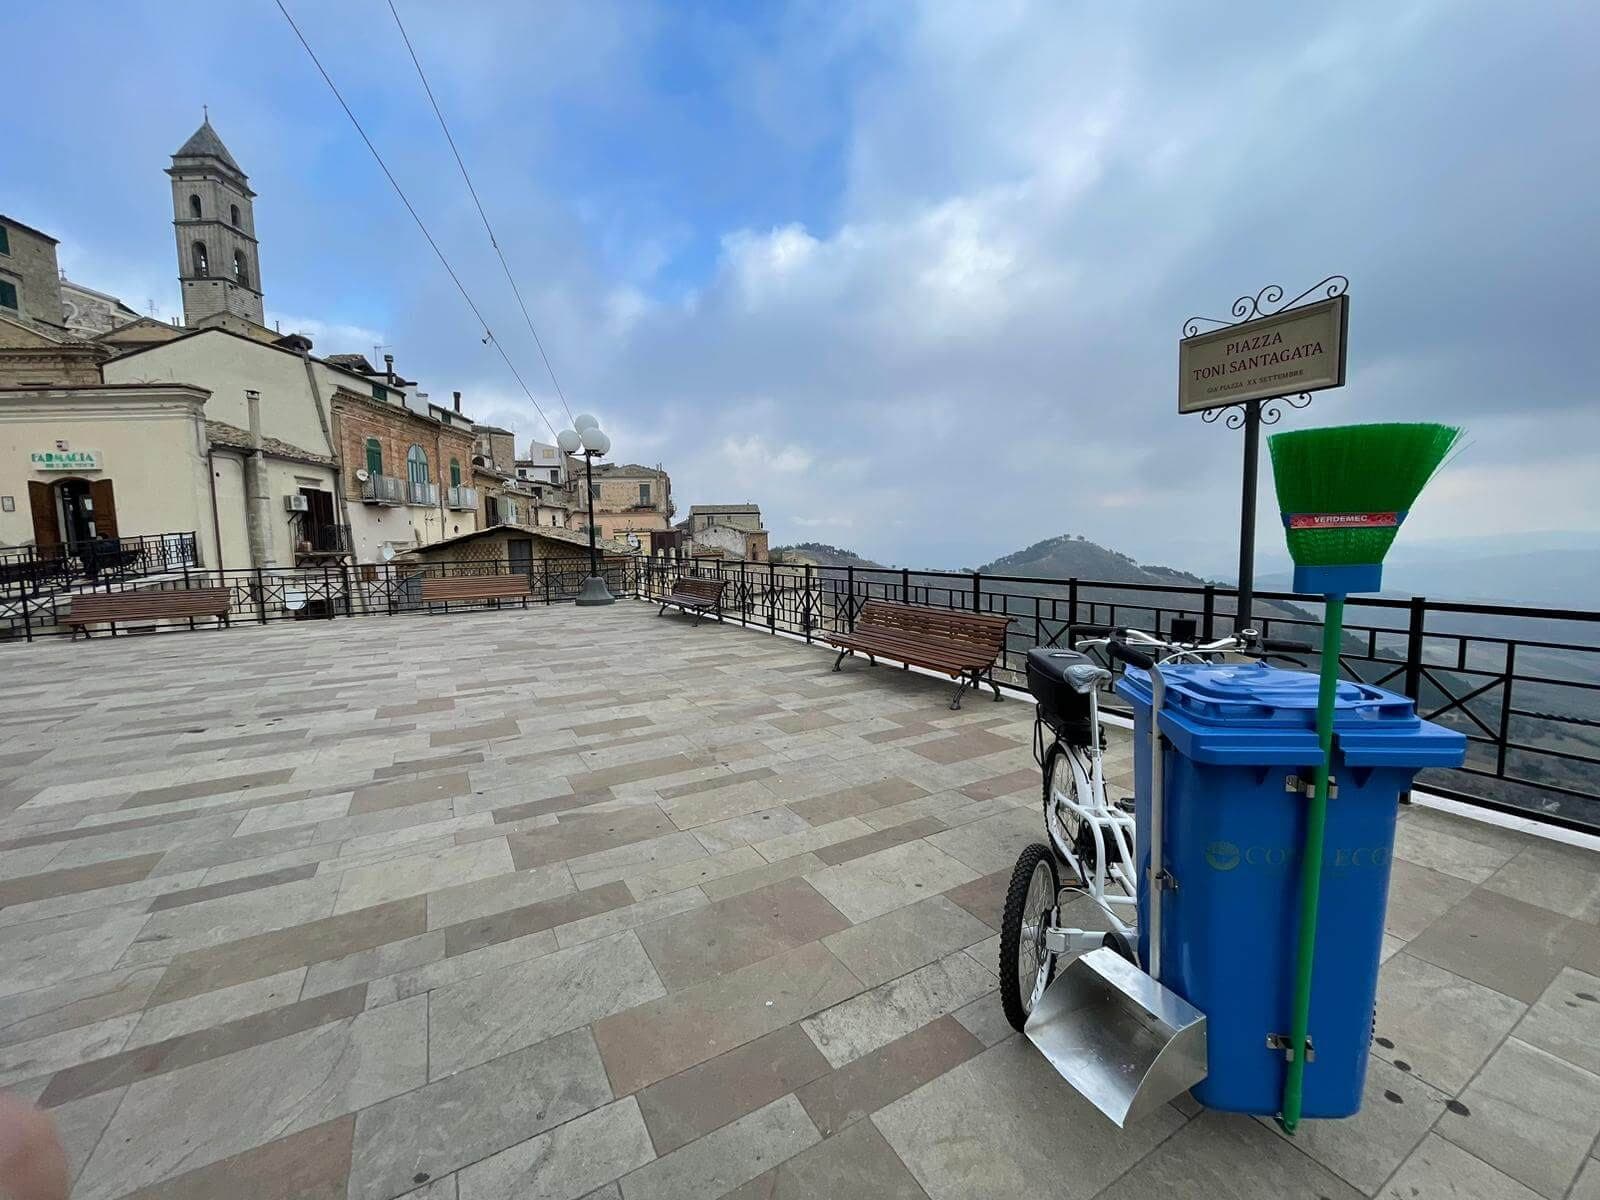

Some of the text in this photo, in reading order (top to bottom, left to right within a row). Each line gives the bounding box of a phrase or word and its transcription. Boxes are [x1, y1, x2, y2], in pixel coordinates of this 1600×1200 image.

[1226, 332, 1283, 356] PIAZZA
[1193, 342, 1323, 381] TONI SANTAGATA
[1219, 382, 1243, 391] PIAZZA
[1259, 369, 1304, 383] SETTEMBRE
[31, 453, 93, 462] FARMACIA
